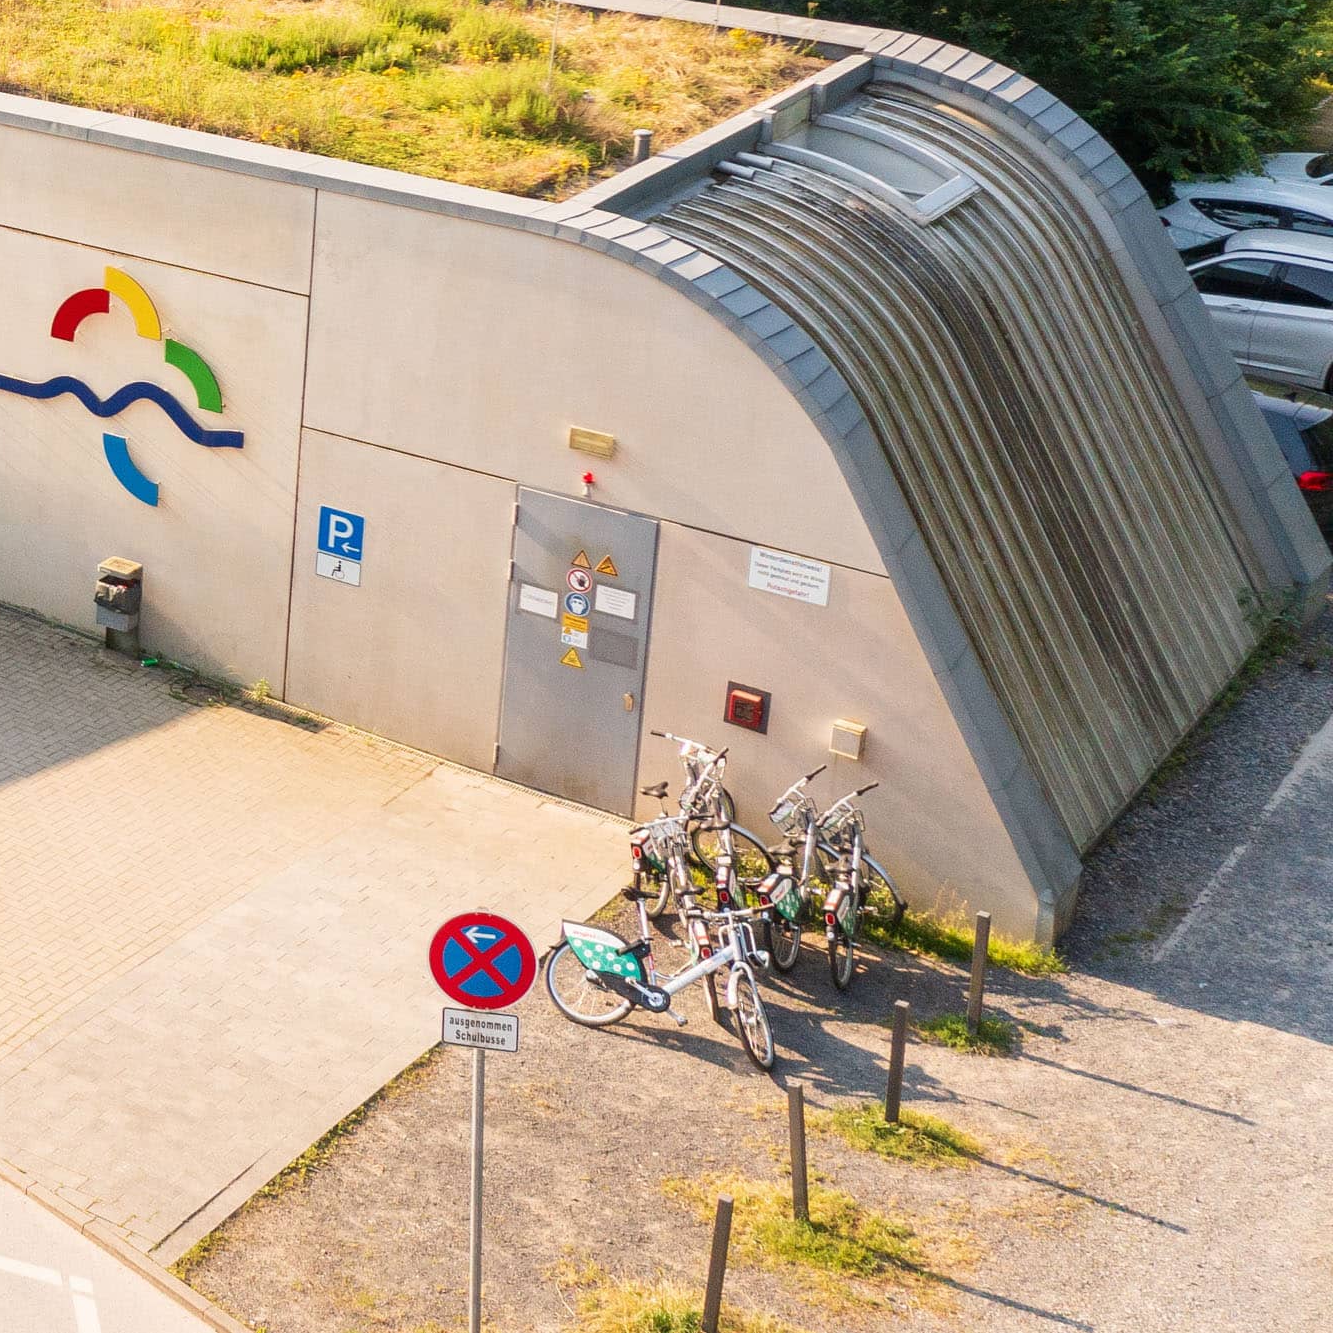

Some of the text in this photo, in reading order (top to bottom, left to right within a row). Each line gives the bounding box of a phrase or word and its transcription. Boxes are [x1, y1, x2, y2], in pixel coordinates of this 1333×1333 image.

[327, 513, 354, 548] P
[449, 1016, 513, 1032] ausgenommen
[455, 1029, 506, 1046] Schulbusse
